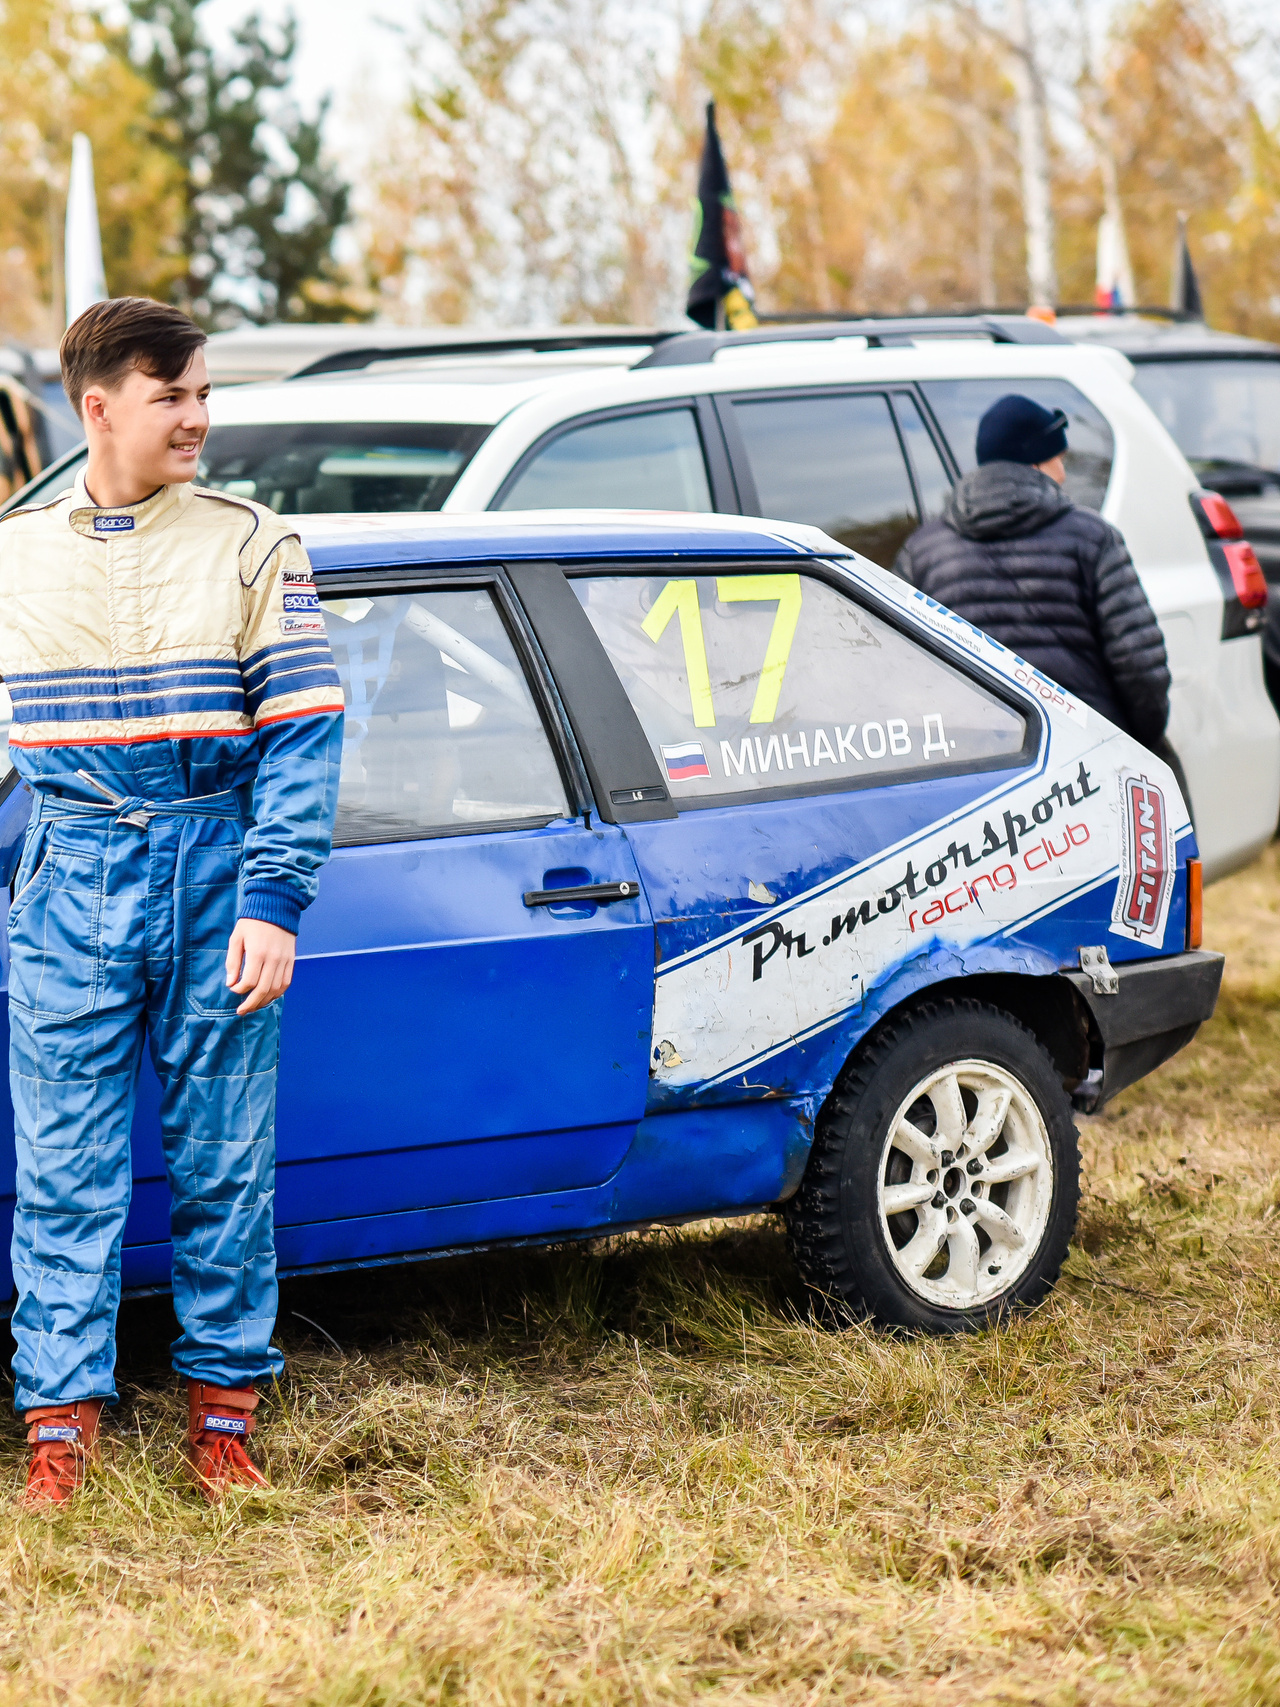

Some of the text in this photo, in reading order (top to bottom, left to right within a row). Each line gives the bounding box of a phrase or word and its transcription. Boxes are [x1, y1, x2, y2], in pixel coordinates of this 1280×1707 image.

[95, 518, 132, 529] sparco
[640, 573, 802, 728] 17
[1014, 668, 1076, 714] СПОРТ
[720, 713, 956, 777] МИНАКОВ Д.
[909, 822, 1090, 932] racing club
[1136, 801, 1157, 907] TITAN
[206, 1417, 244, 1431] sparco
